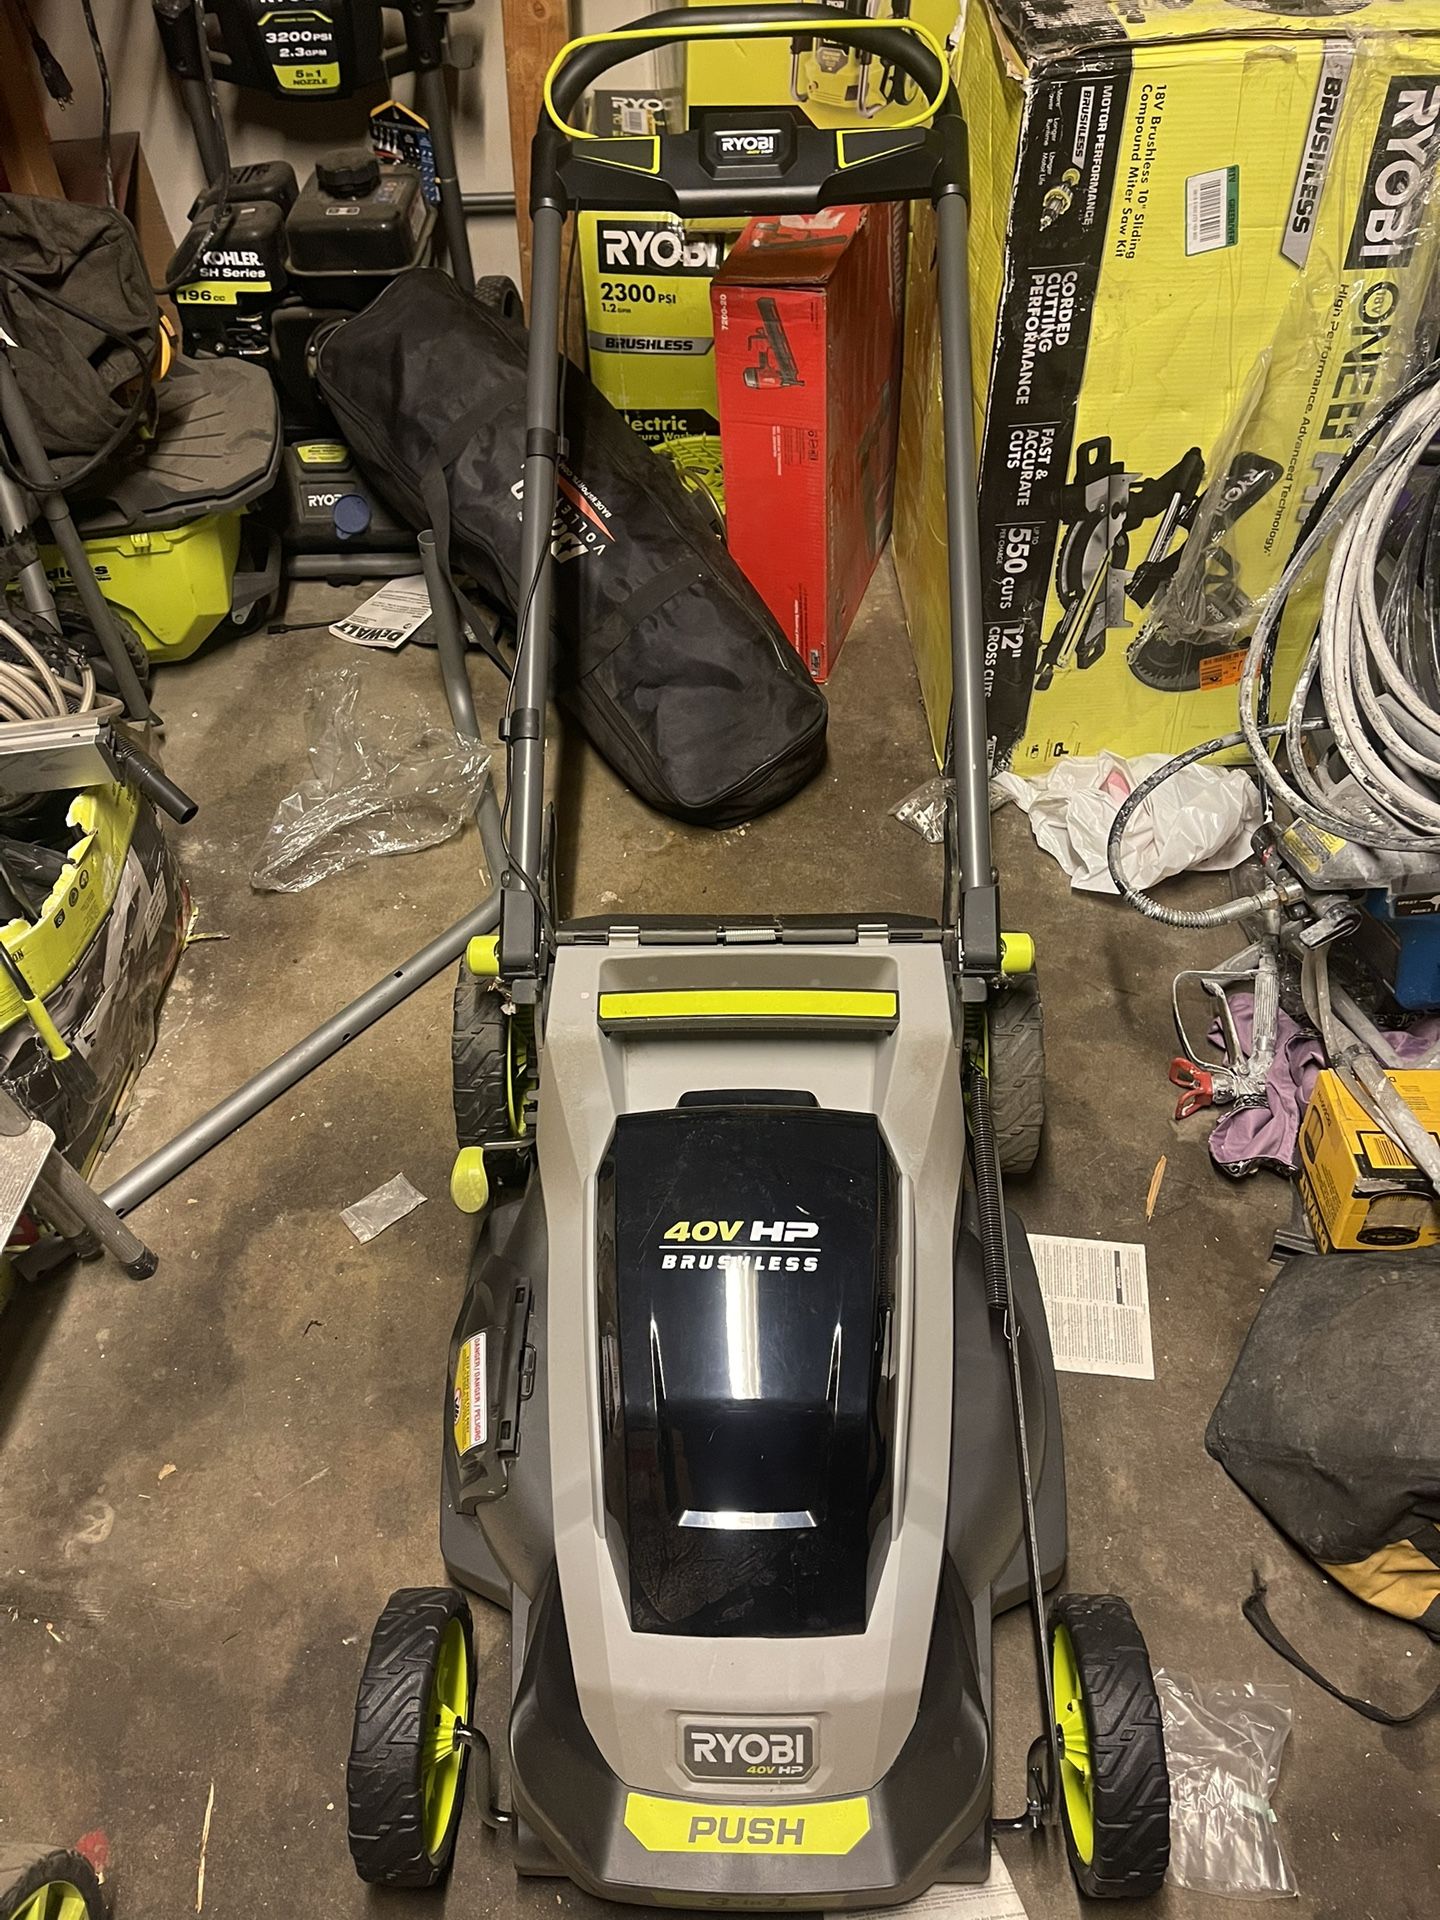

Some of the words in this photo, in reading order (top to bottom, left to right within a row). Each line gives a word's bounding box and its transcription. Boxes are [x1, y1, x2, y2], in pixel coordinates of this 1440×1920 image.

[1097, 85, 1113, 132] MOTOR
[1153, 84, 1167, 110] 18V
[1075, 90, 1092, 157] BRUSHLESS
[1131, 84, 1153, 162] Compound
[721, 136, 774, 151] RYOBI
[1140, 116, 1162, 183] Brushless
[1292, 77, 1343, 234] BRUSHLESS
[1084, 134, 1107, 225] PERFORMANCE
[1125, 166, 1139, 203] Miter
[1360, 86, 1440, 257] RYOBI
[1137, 189, 1149, 209] 10"
[1120, 208, 1133, 235] Saw
[1126, 214, 1145, 259] Sliding
[603, 230, 718, 268] RYOBI
[1115, 240, 1127, 257] Kit
[200, 267, 219, 277] SH
[222, 268, 266, 278] Series
[601, 283, 656, 303] 2300
[658, 294, 676, 304] PSI
[602, 303, 616, 313] 1.2
[1055, 271, 1078, 346] CORDED
[1038, 272, 1062, 353] CUTTING
[605, 337, 693, 351] BRUSHLESS
[1015, 274, 1046, 405] PERFORMANCE
[1006, 430, 1024, 469] CUTS
[1037, 428, 1055, 465] FAST
[1285, 417, 1310, 481] Advanced
[1016, 428, 1040, 506] ACCURATE
[1035, 469, 1048, 480] &
[1004, 528, 1031, 574] 550
[999, 577, 1015, 609] CUTS
[984, 626, 1001, 666] CROSS
[663, 1220, 745, 1242] 40V
[750, 1220, 820, 1242] HP
[661, 1254, 819, 1272] BRUSHLESS
[691, 1732, 804, 1764] RYOBI
[747, 1766, 775, 1774] 40V
[778, 1766, 803, 1774] HP
[688, 1816, 805, 1846] PUSH
